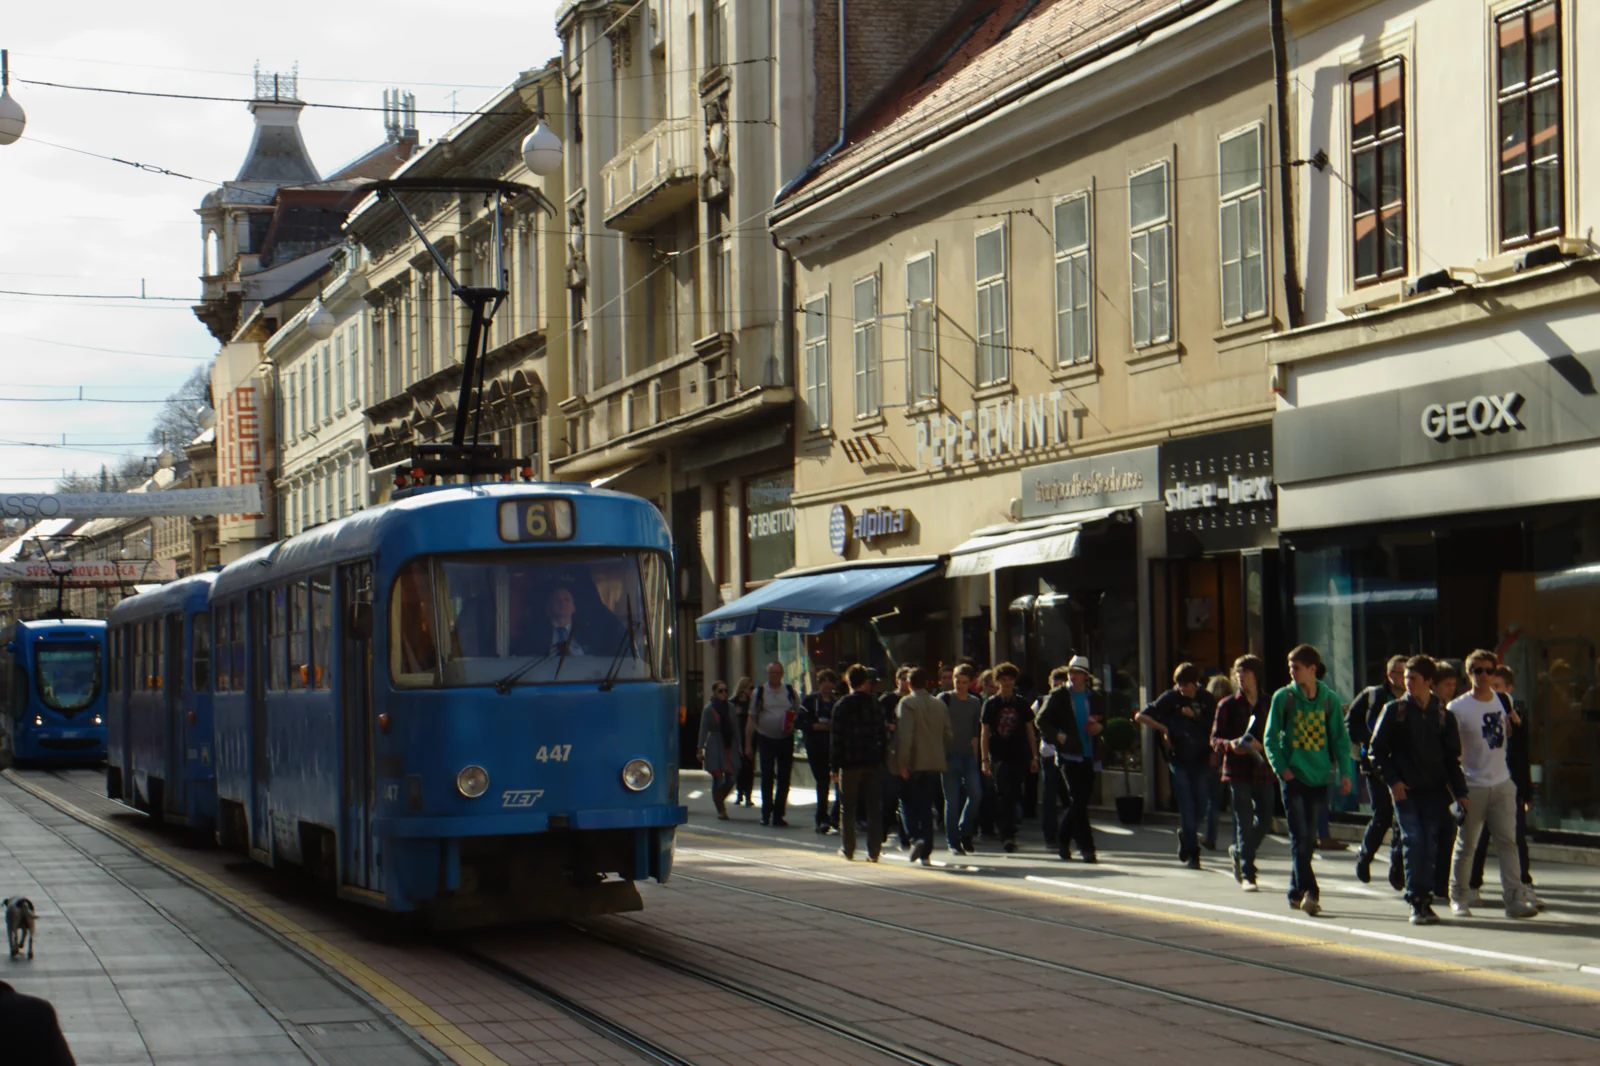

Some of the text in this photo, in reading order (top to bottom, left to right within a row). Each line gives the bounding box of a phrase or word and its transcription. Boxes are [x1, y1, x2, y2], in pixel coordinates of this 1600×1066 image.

[916, 390, 1062, 469] PEPERMINT
[1421, 391, 1518, 438] GEOX
[236, 387, 264, 520] AGMA
[526, 503, 547, 536] 6
[853, 505, 905, 541] alpina
[536, 744, 572, 763] 447
[502, 789, 545, 807] ZET
